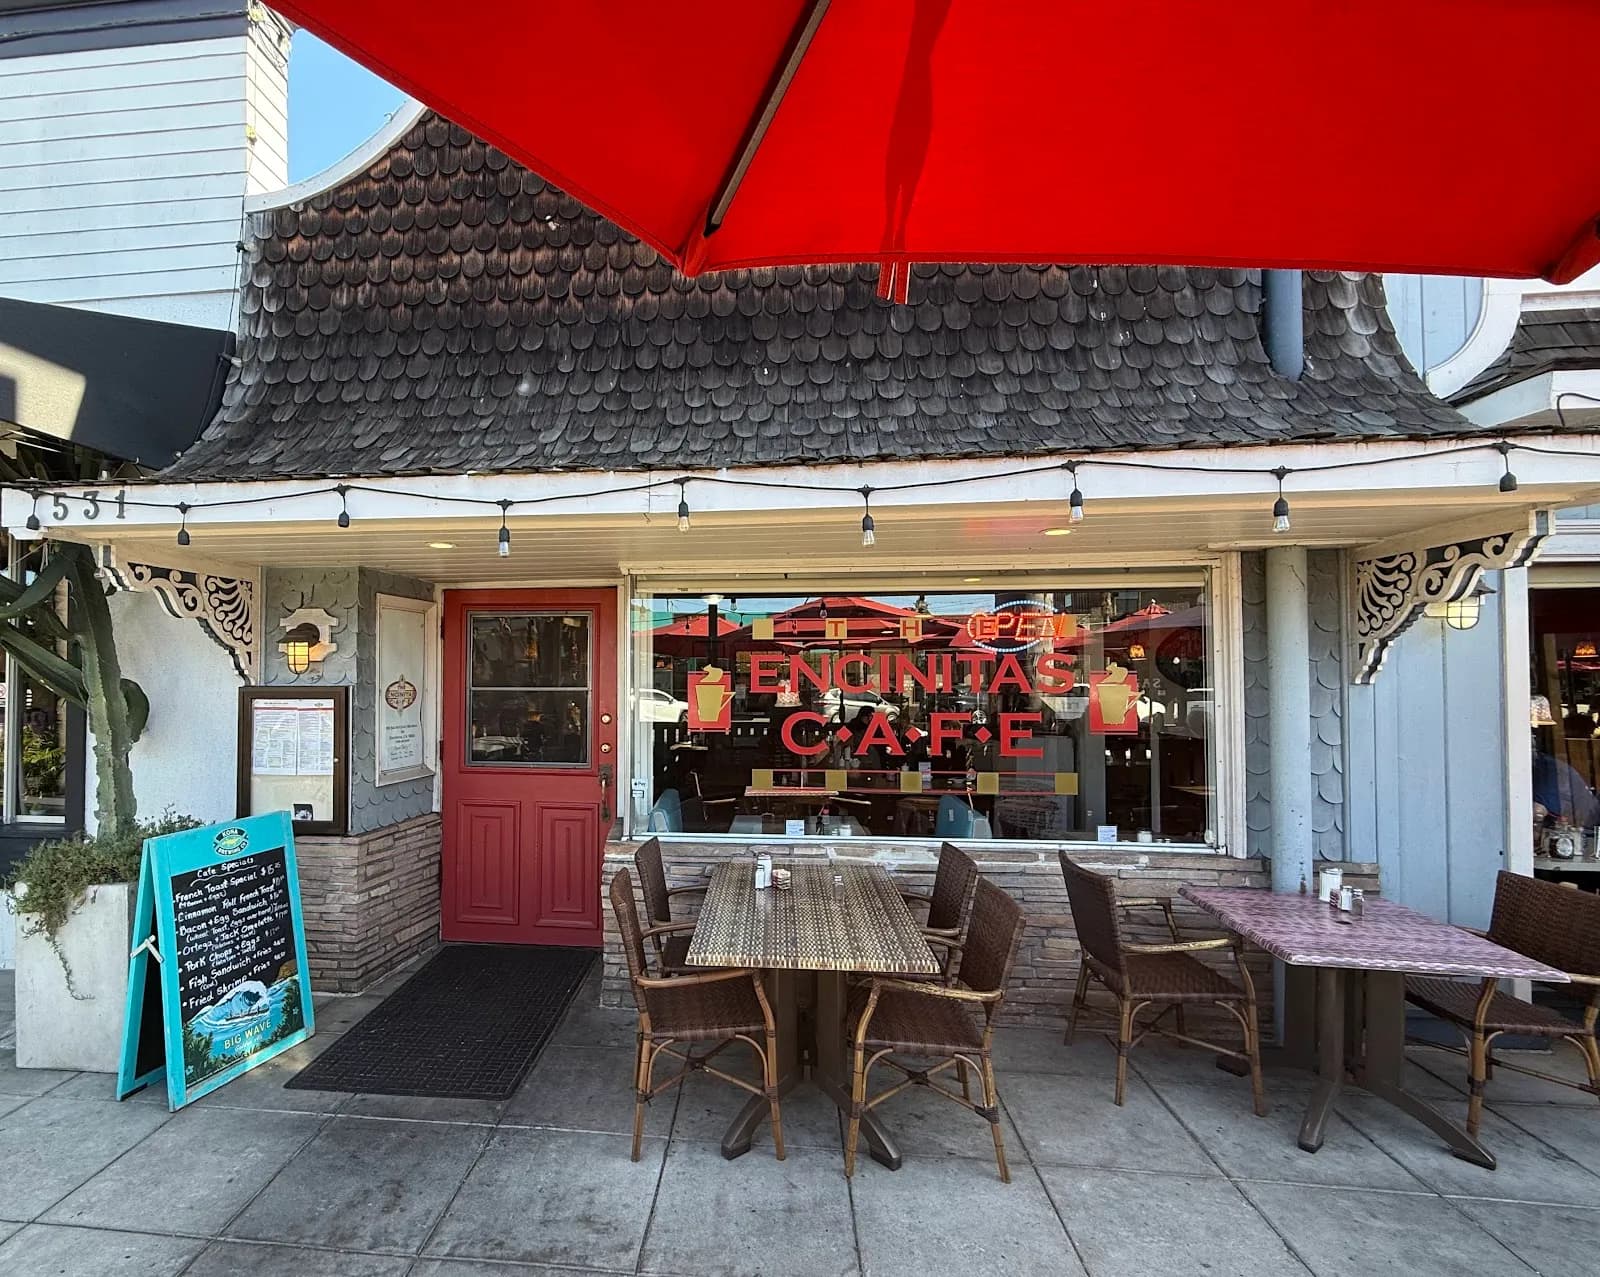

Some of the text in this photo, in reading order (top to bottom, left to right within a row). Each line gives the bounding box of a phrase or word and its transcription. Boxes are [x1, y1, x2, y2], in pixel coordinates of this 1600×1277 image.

[53, 490, 126, 521] 531
[967, 612, 1066, 641] OPEN
[749, 652, 1076, 694] ENCINITAS
[222, 828, 239, 837] KONA
[197, 857, 254, 878] Cafe Specials
[175, 889, 204, 902] French
[205, 879, 228, 893] Toast
[230, 871, 258, 886] Special
[178, 905, 217, 922] Cinnamon
[222, 897, 237, 909] Roll
[179, 922, 207, 936] Bacon
[214, 915, 230, 925] Egg
[232, 898, 268, 916] Sandwich
[183, 941, 213, 956] Ortega
[220, 928, 240, 941] Jack
[184, 956, 206, 972] Pork
[209, 948, 233, 962] Chops
[240, 935, 261, 949] Eggs
[188, 973, 208, 990] Fish
[210, 956, 252, 979] Sandwich
[256, 946, 272, 958] Fries
[189, 990, 214, 1009] Fried
[216, 975, 248, 995] Shrimp
[253, 961, 271, 975] Fries
[224, 1018, 272, 1050] BIG WAVE
